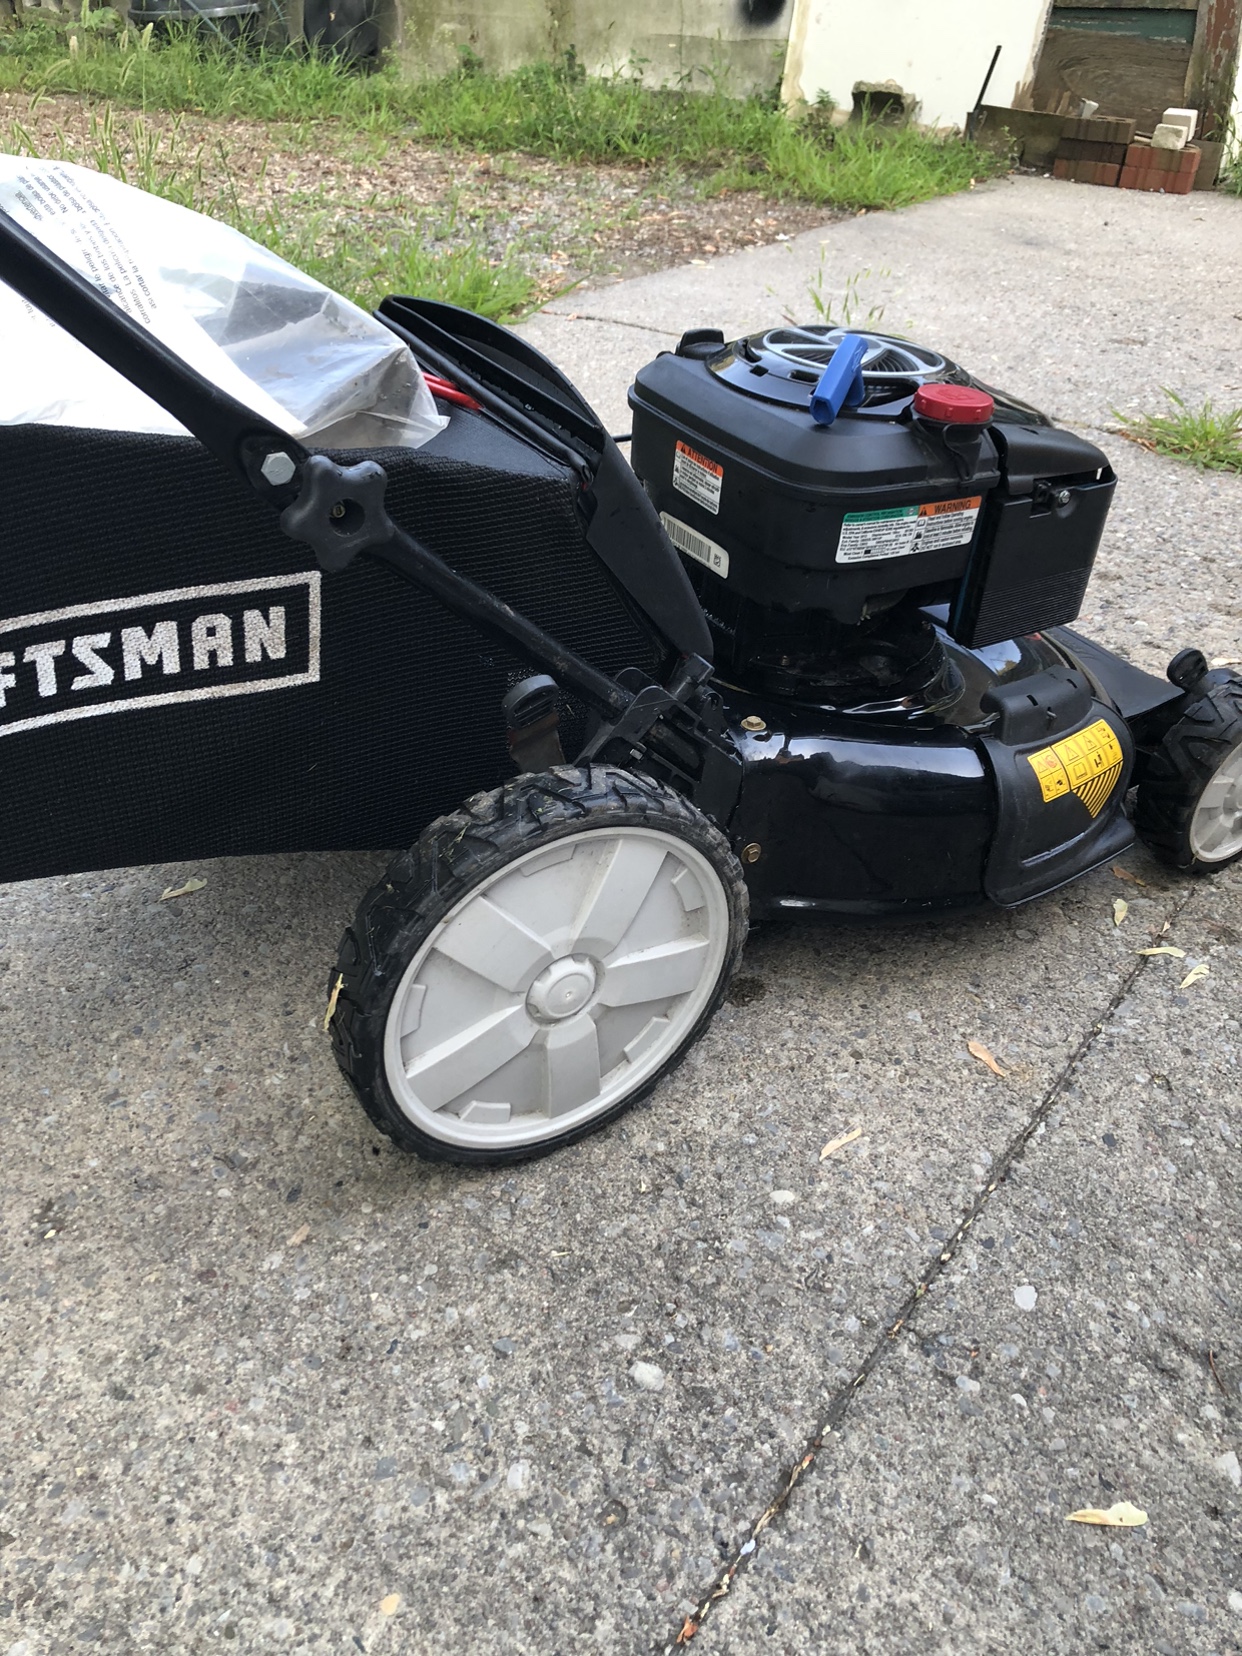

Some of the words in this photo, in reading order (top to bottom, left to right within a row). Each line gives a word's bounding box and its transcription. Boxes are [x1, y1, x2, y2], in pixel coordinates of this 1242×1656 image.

[30, 189, 46, 205] bolsa
[67, 195, 83, 212] bolsa
[42, 202, 55, 216] esta
[58, 202, 68, 214] No
[134, 272, 151, 297] cortar
[687, 447, 719, 474] ATTENTION
[934, 499, 971, 515] WARNING
